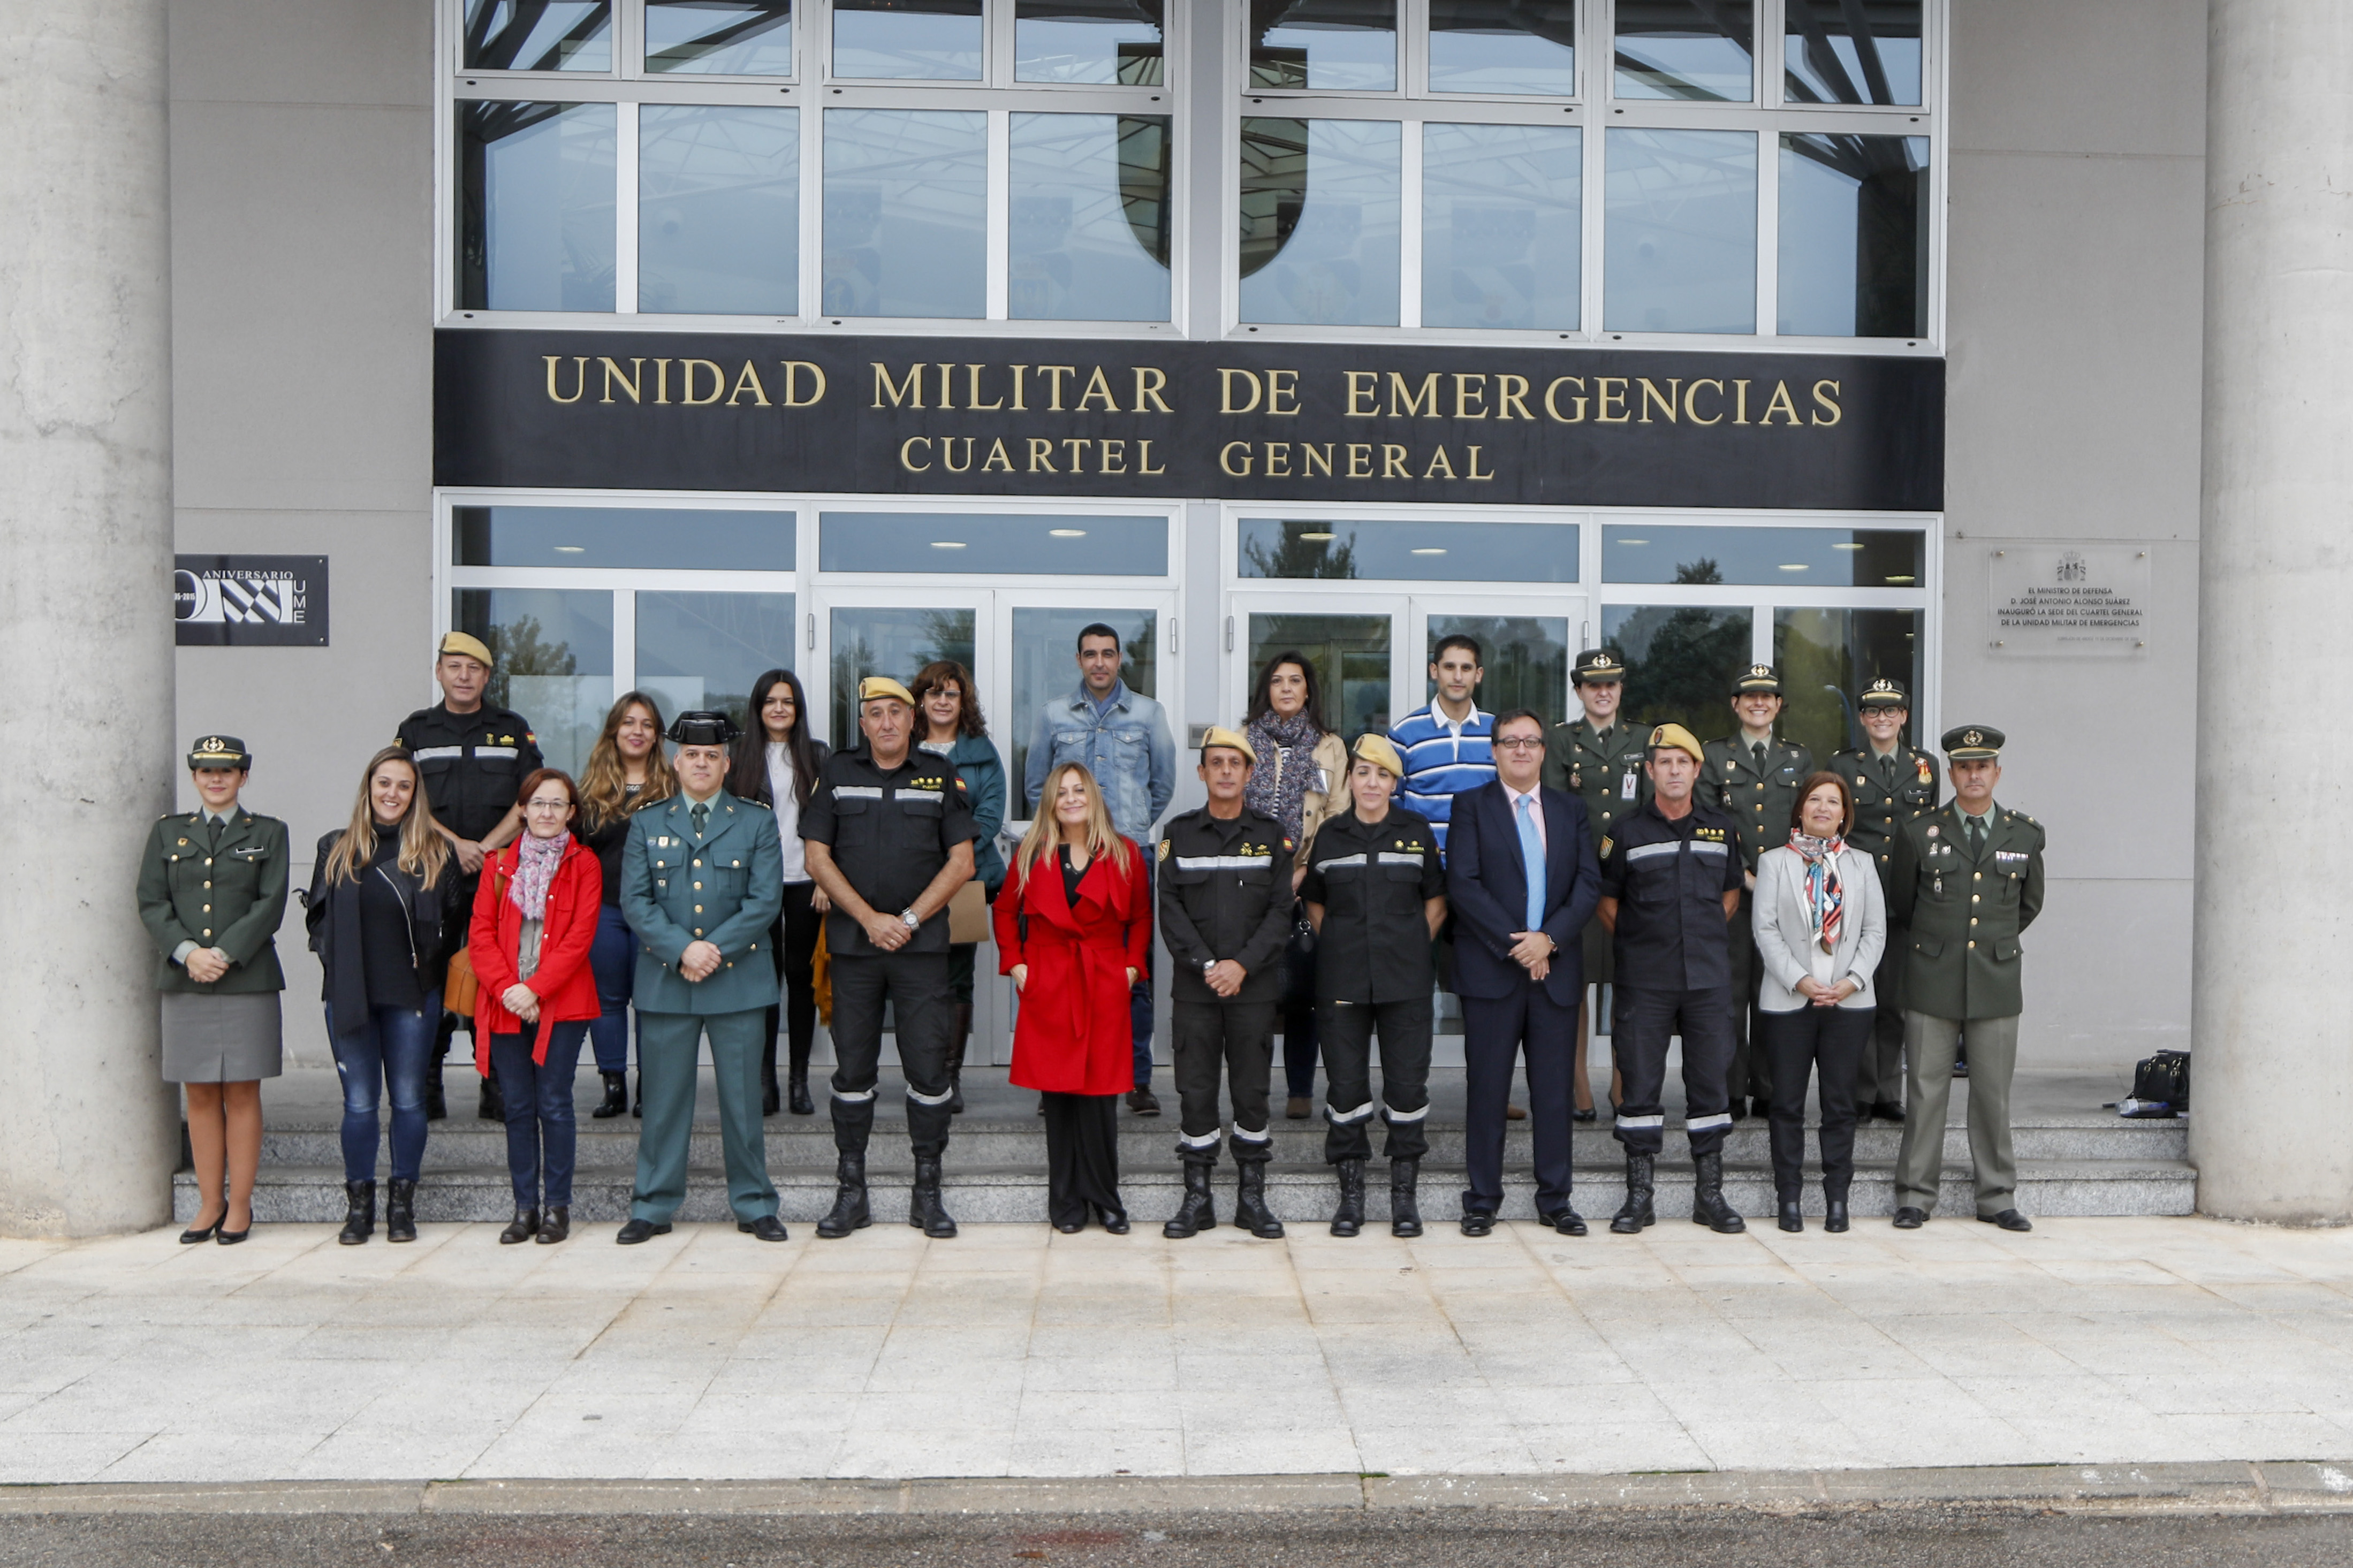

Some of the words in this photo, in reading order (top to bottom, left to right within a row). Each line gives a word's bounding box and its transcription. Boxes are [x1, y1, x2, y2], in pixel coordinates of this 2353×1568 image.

[542, 355, 826, 407] UNIDAD
[870, 362, 1174, 413] MILITAR
[1217, 368, 1301, 415] DE
[1343, 371, 1842, 427] EMERGENCIAS
[901, 437, 1165, 475] CUARTEL
[1220, 441, 1495, 480] GENERAL
[202, 570, 294, 580] ANIVERSARIO
[2020, 596, 2037, 604] JOSÉ
[2105, 597, 2130, 605] SUÁREZ
[1998, 607, 2036, 615] INAUGURÓ
